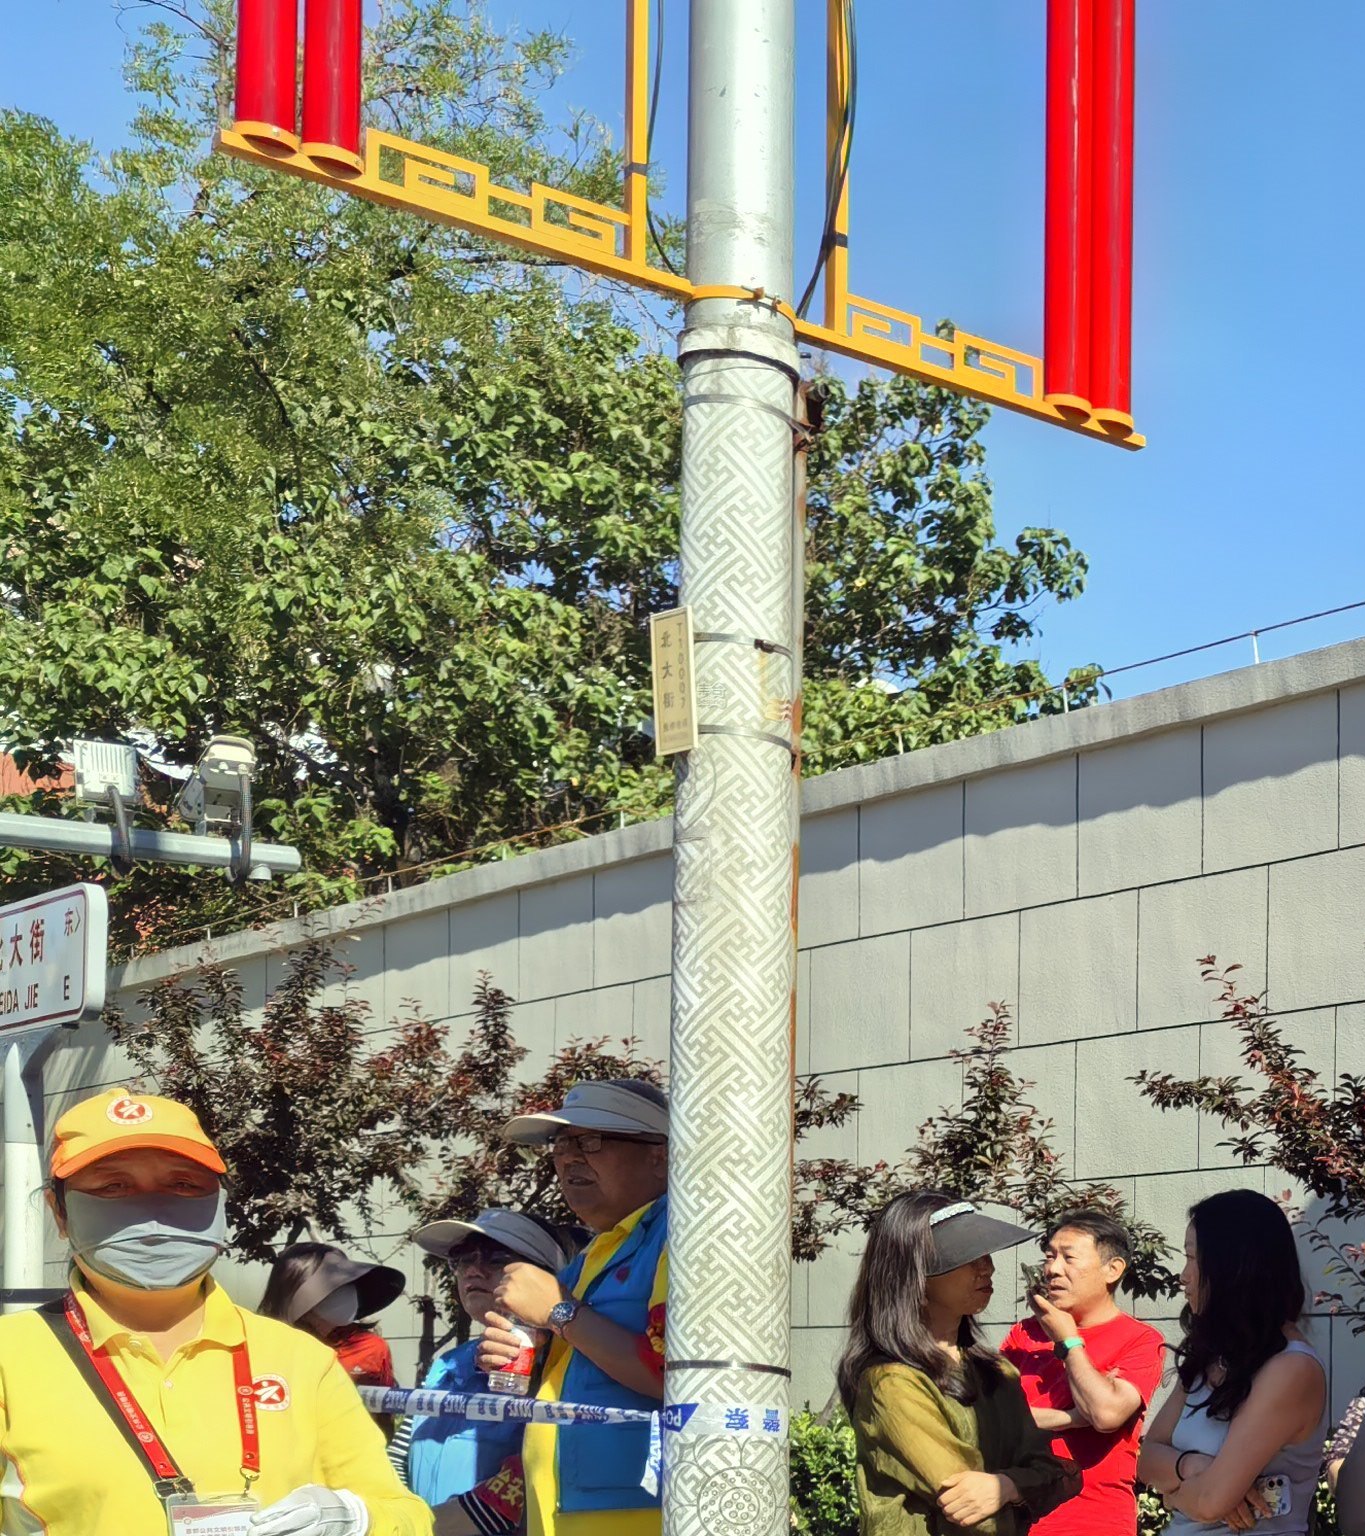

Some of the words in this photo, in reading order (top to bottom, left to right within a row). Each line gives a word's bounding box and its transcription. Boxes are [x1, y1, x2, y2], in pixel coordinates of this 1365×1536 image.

[64, 907, 74, 937] 东
[0, 918, 45, 971] 大街
[25, 983, 39, 1010] JIE
[63, 974, 71, 1001] E
[725, 1407, 781, 1432] 警察
